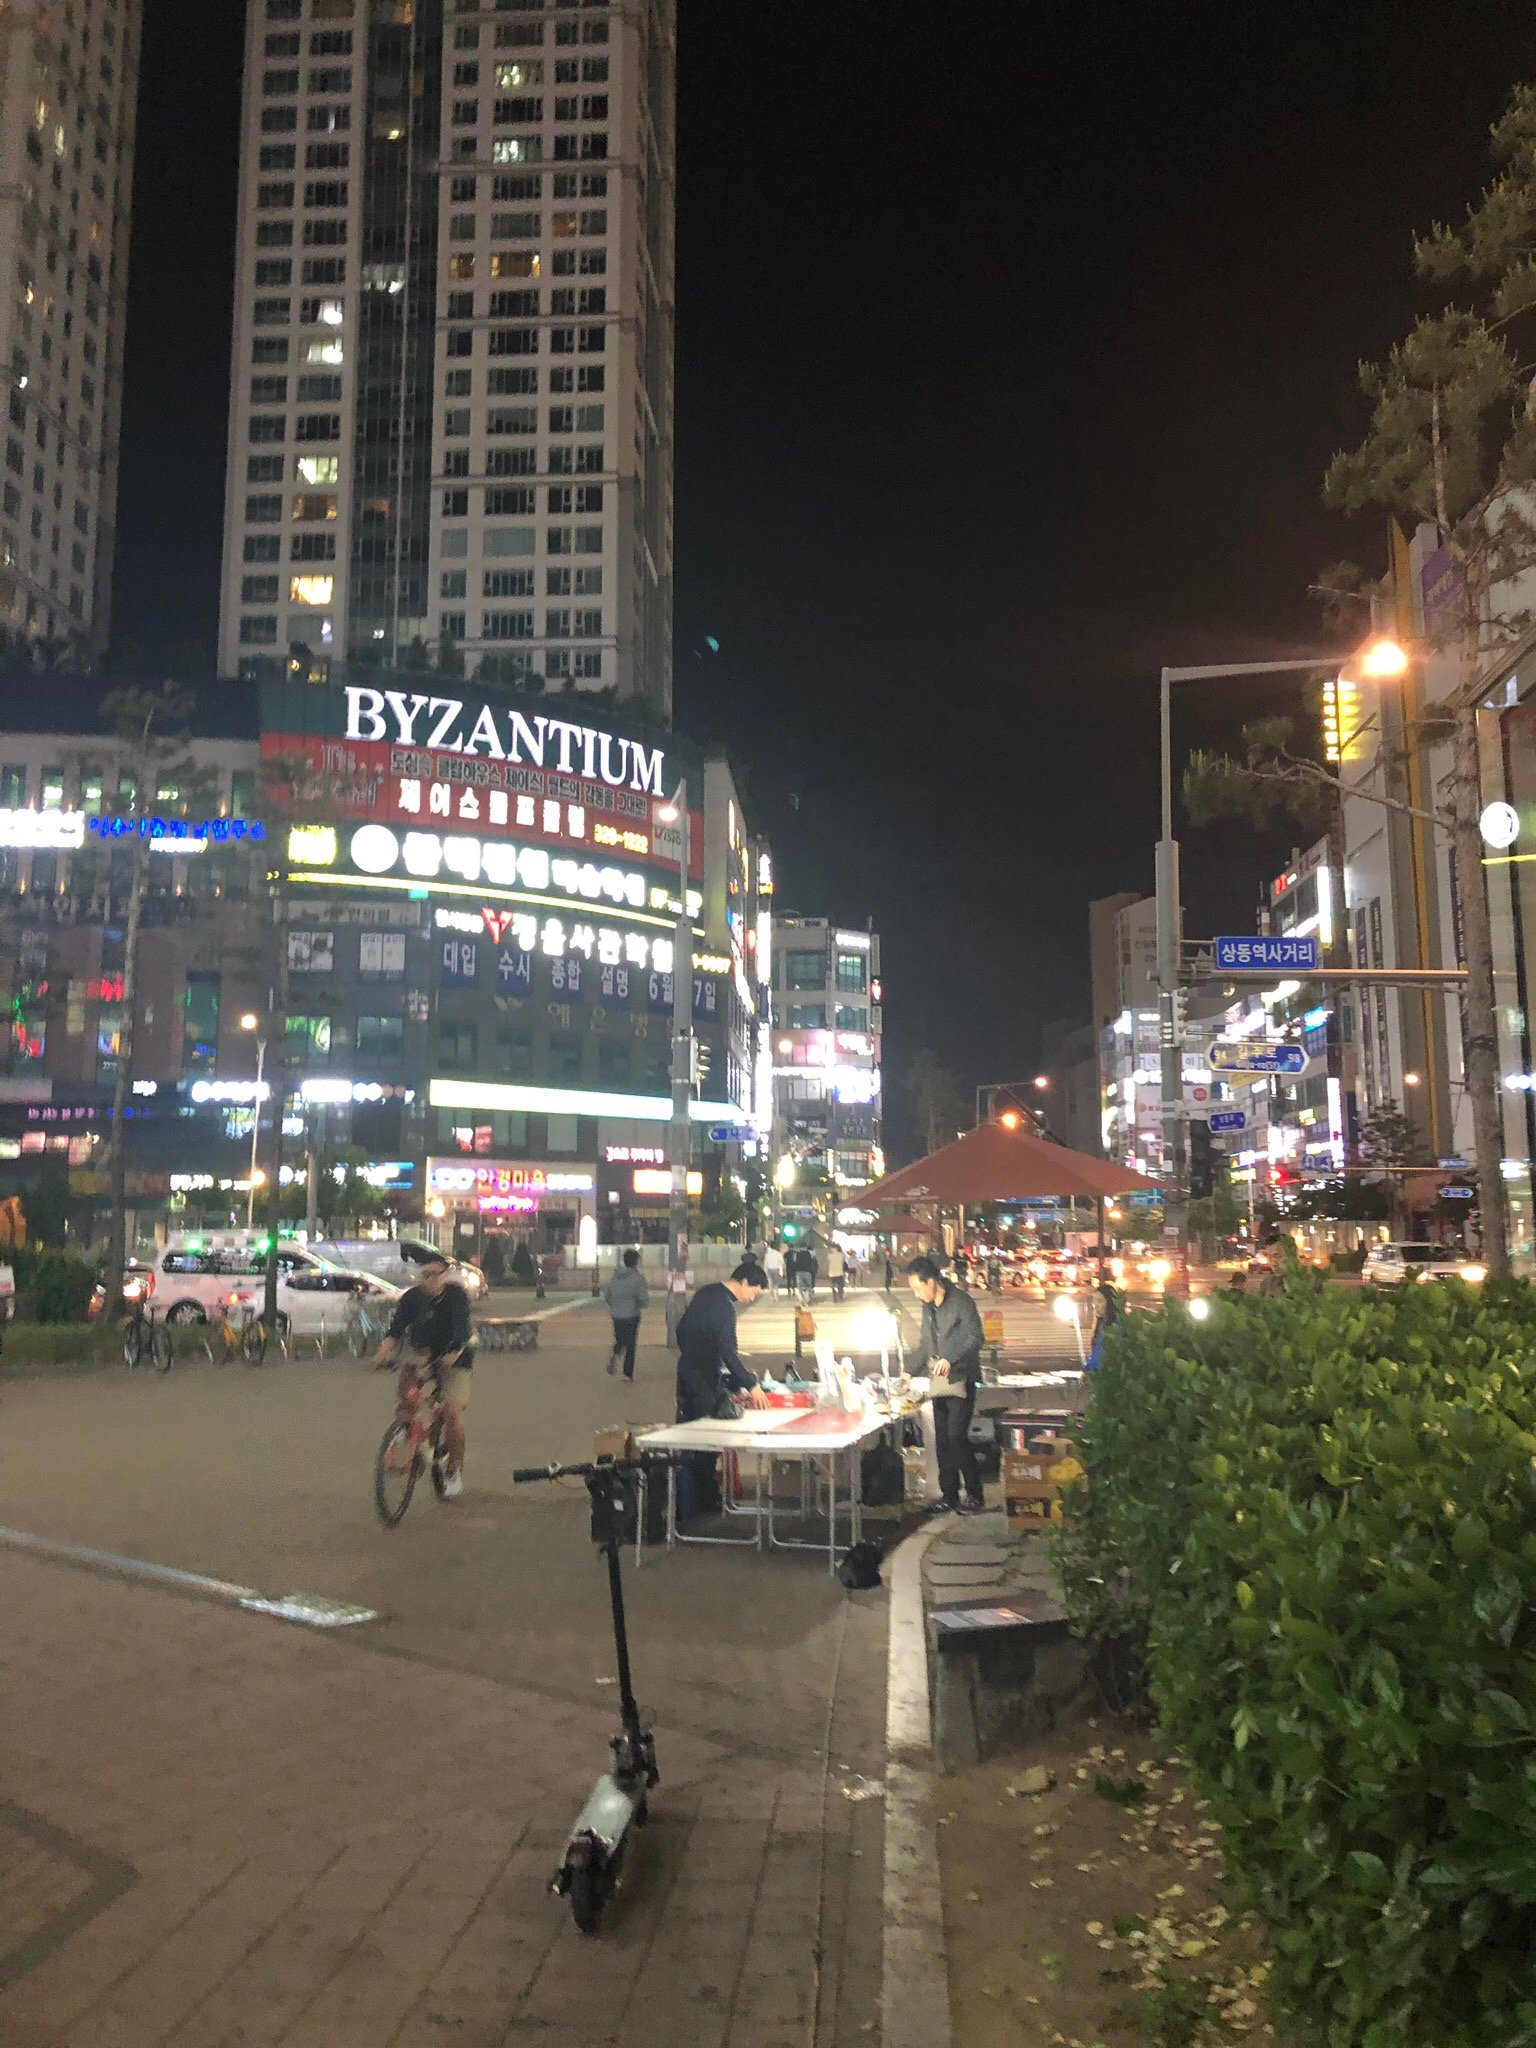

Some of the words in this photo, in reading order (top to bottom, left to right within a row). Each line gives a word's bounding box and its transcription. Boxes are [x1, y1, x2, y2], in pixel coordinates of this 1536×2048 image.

[345, 686, 664, 796] BYZANTIUM
[1221, 943, 1314, 963] 상동역사거리
[443, 941, 476, 977] 대입
[499, 950, 531, 984] 수시
[551, 957, 581, 991] 종합
[601, 966, 629, 998] 설명
[649, 974, 674, 1004] 6월
[693, 979, 716, 1012] 7일
[1237, 1045, 1278, 1060] 길주로
[477, 1168, 545, 1195] 안경마을
